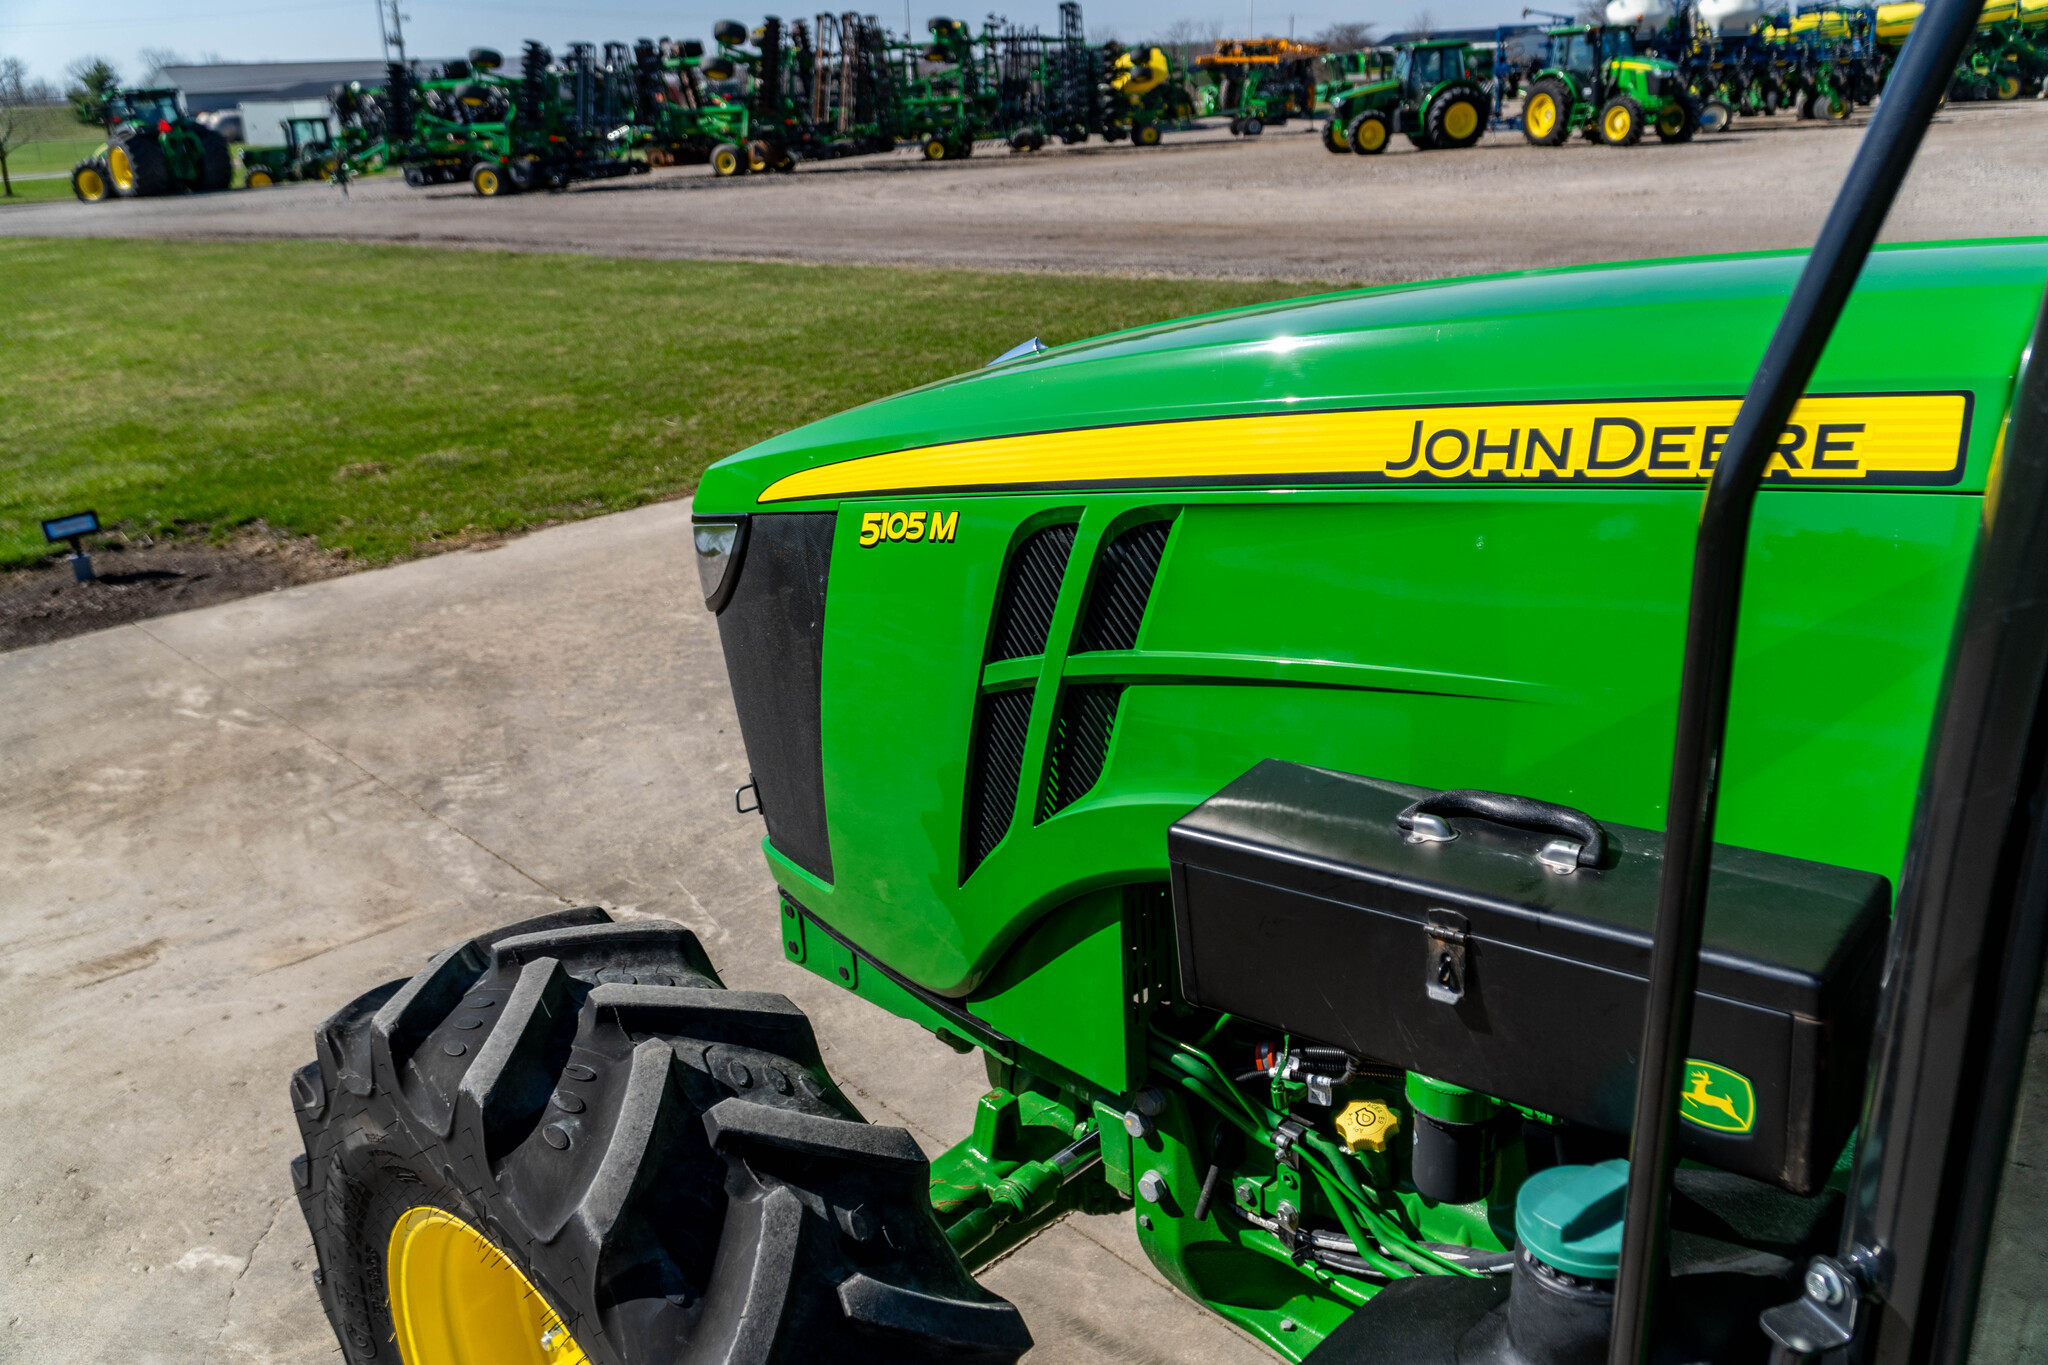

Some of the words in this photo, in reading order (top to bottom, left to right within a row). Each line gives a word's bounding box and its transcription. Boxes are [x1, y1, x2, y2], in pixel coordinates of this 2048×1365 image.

[1385, 419, 1573, 470] JOHN
[1586, 416, 1867, 470] DEERE
[859, 510, 928, 549] 5105
[928, 510, 960, 543] M
